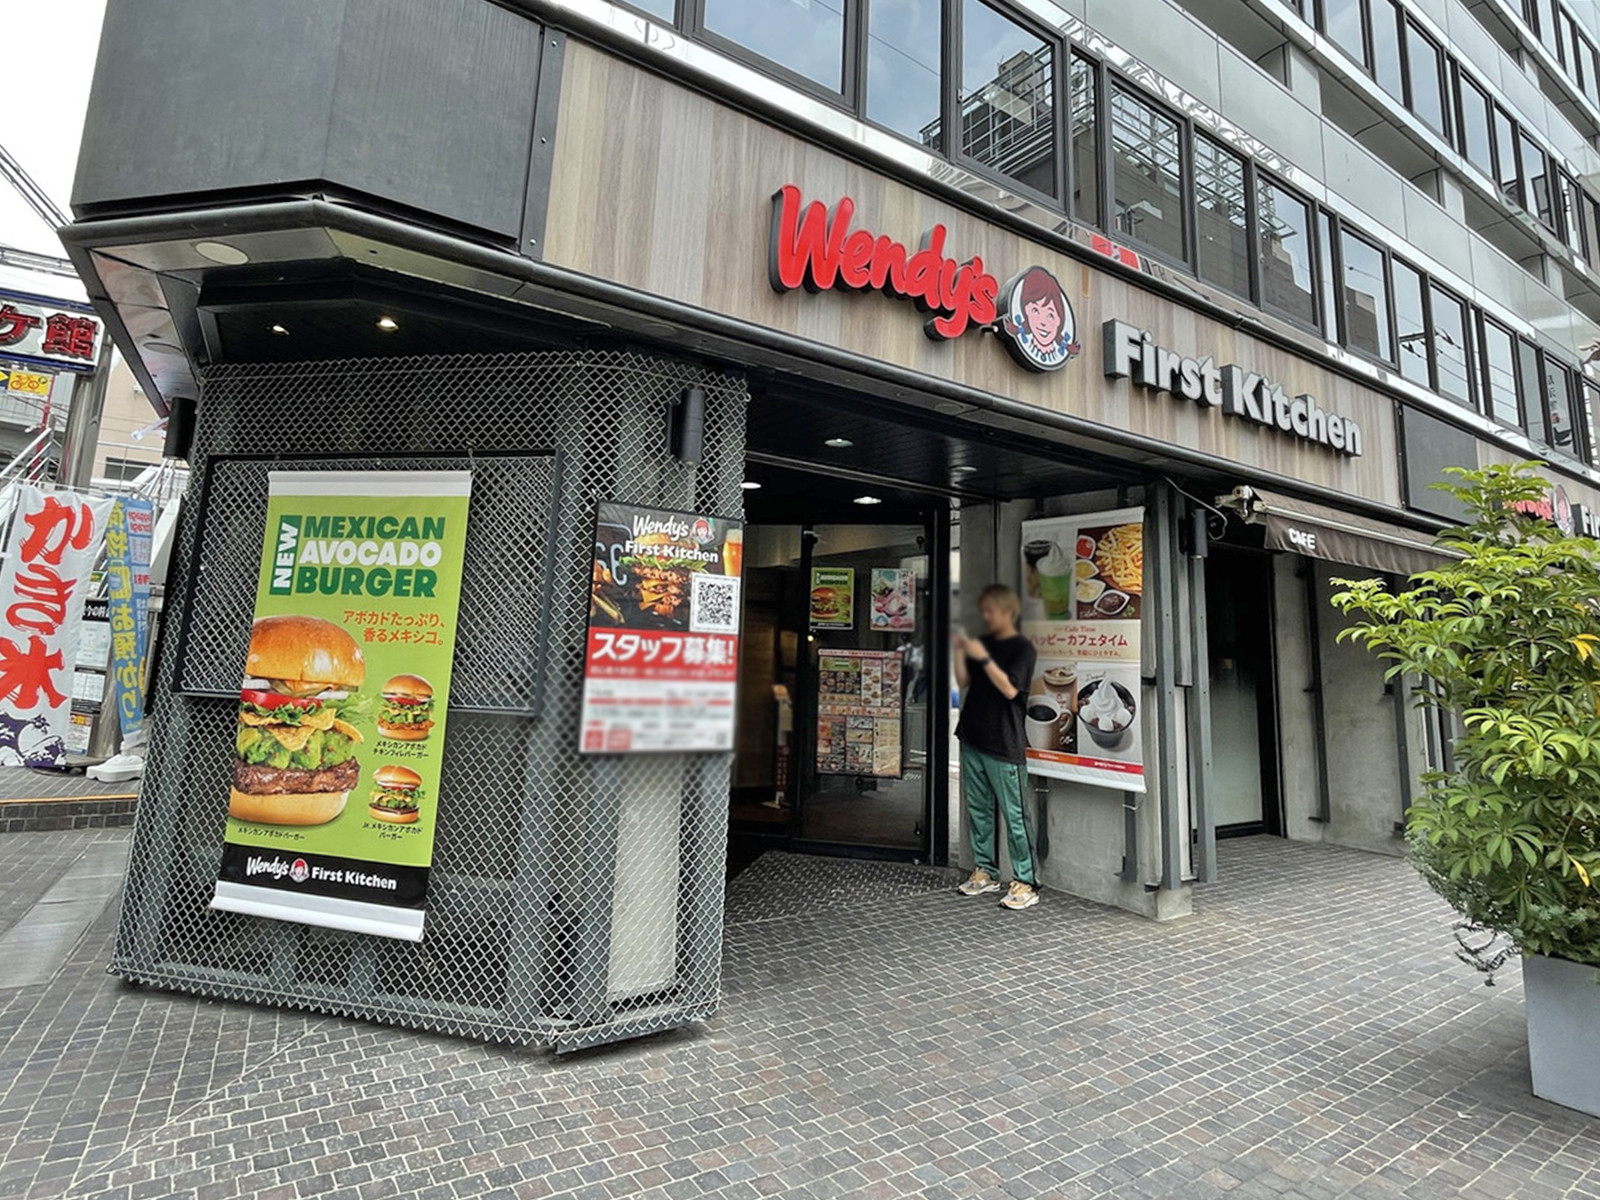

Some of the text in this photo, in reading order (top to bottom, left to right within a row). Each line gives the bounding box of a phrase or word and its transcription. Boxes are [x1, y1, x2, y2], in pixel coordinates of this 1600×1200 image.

[777, 183, 1363, 457] Wendy's First Kitchen
[303, 516, 446, 540] MEXICAN
[632, 515, 690, 541] Wendy's
[1287, 527, 1316, 549] CAFE
[272, 522, 300, 589] NEW
[299, 540, 442, 567] AVOCADO
[625, 540, 719, 563] First Kitchen
[295, 567, 438, 598] BURGER
[0, 496, 95, 709] かき氷
[343, 610, 446, 628] アボカドたっぷり、
[363, 628, 444, 646] 香るメキシコ。
[591, 632, 734, 666] スタッフ募集!
[246, 856, 397, 890] Wendy's First Kitchen
